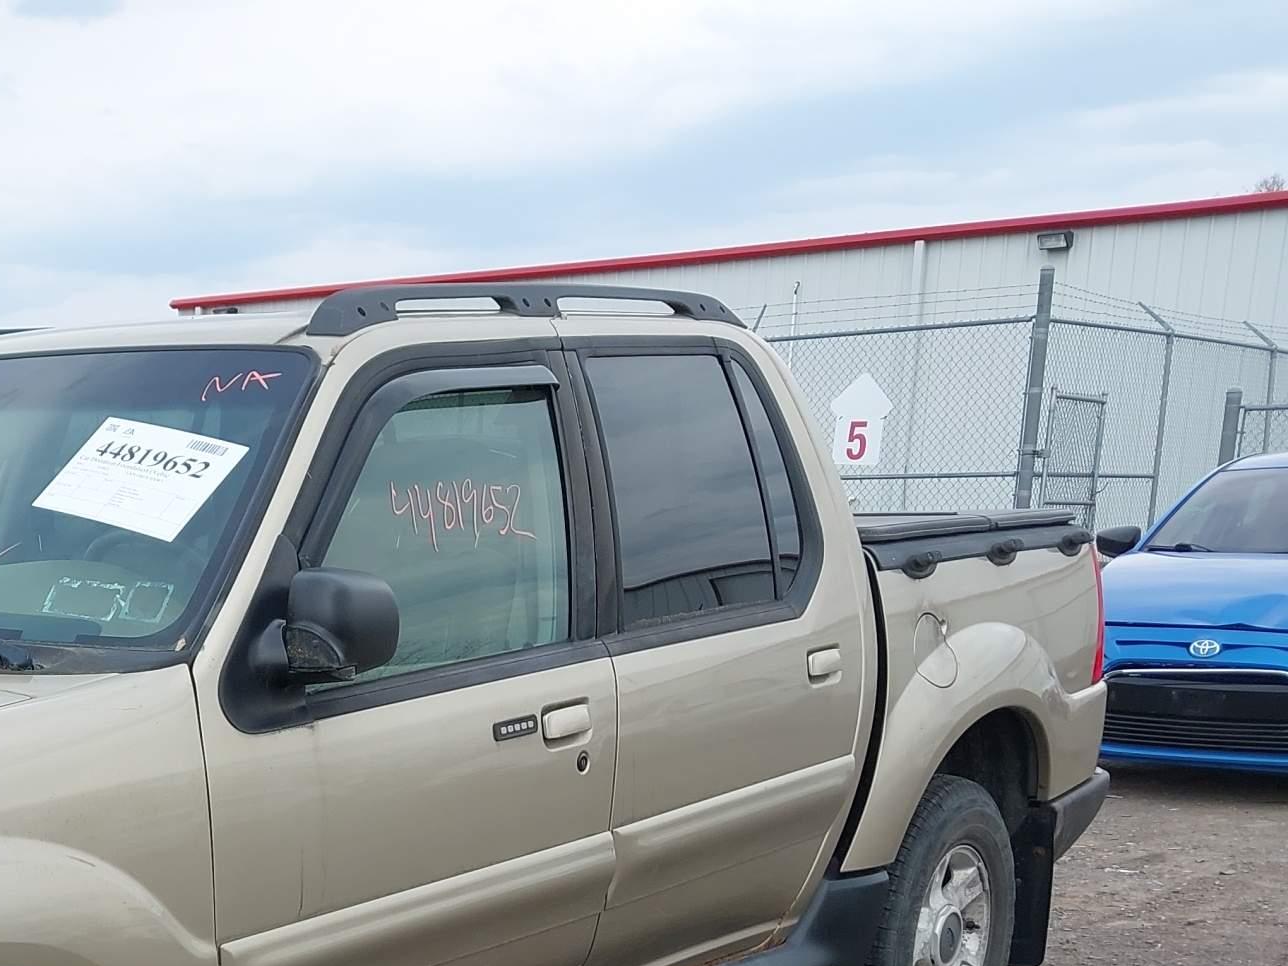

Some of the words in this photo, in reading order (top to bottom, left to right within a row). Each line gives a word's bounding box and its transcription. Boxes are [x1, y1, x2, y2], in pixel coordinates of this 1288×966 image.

[201, 370, 282, 401] NA
[846, 421, 867, 460] 5
[96, 441, 210, 479] 44819652
[391, 478, 536, 552] 44819652
